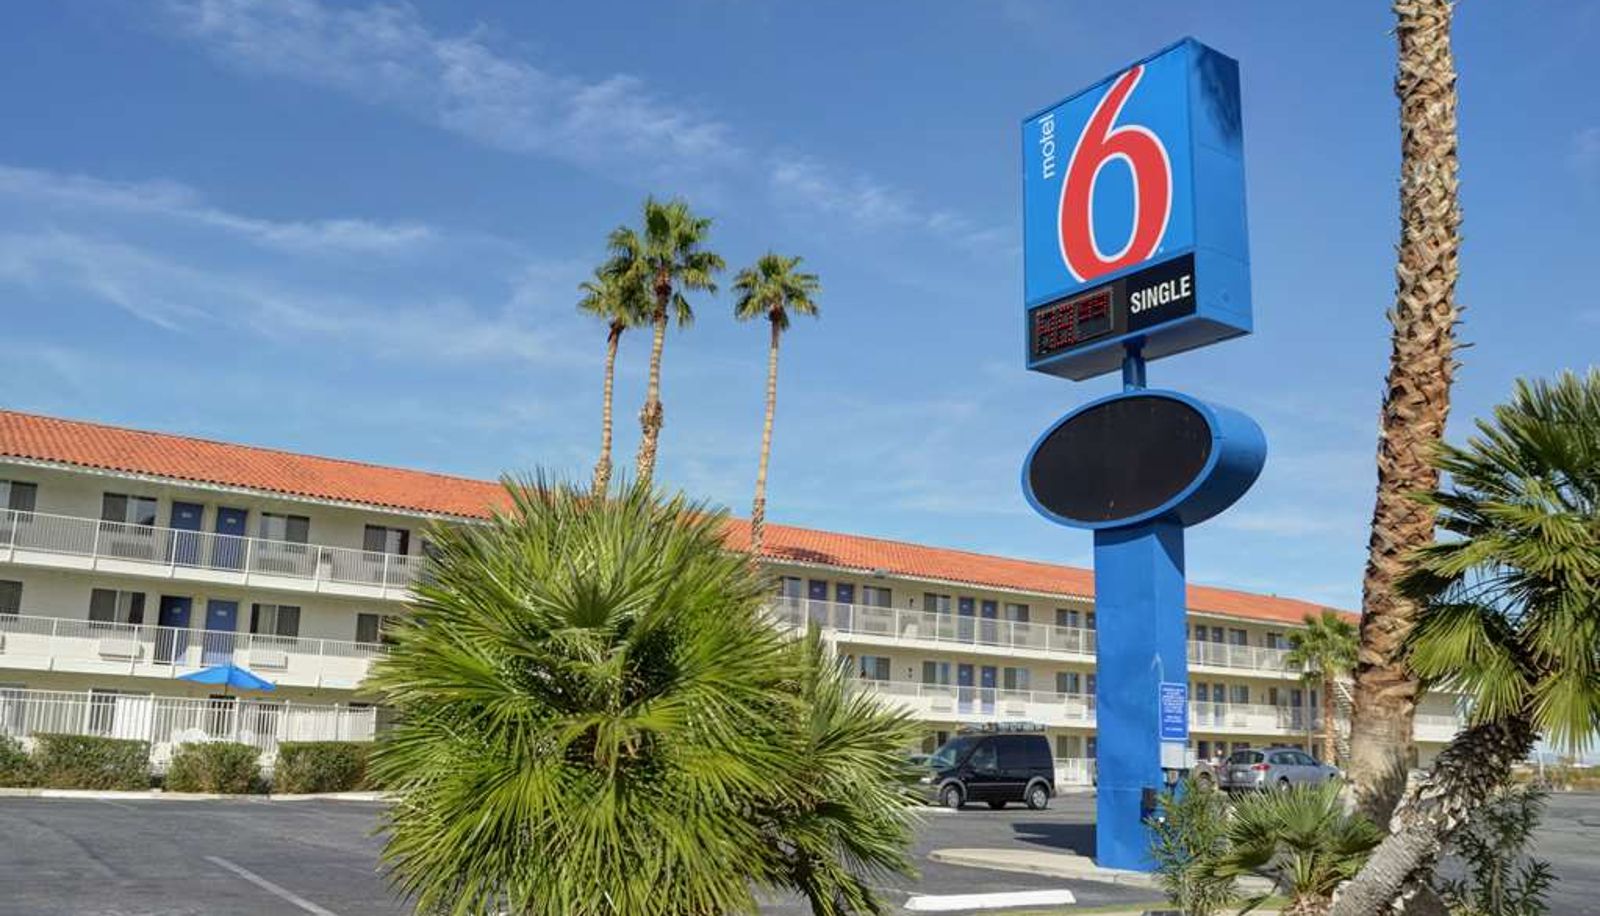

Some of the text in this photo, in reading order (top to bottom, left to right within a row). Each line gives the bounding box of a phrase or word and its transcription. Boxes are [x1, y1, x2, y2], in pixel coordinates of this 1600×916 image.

[1039, 65, 1173, 282] motel 6
[1130, 275, 1191, 314] SINGLE
